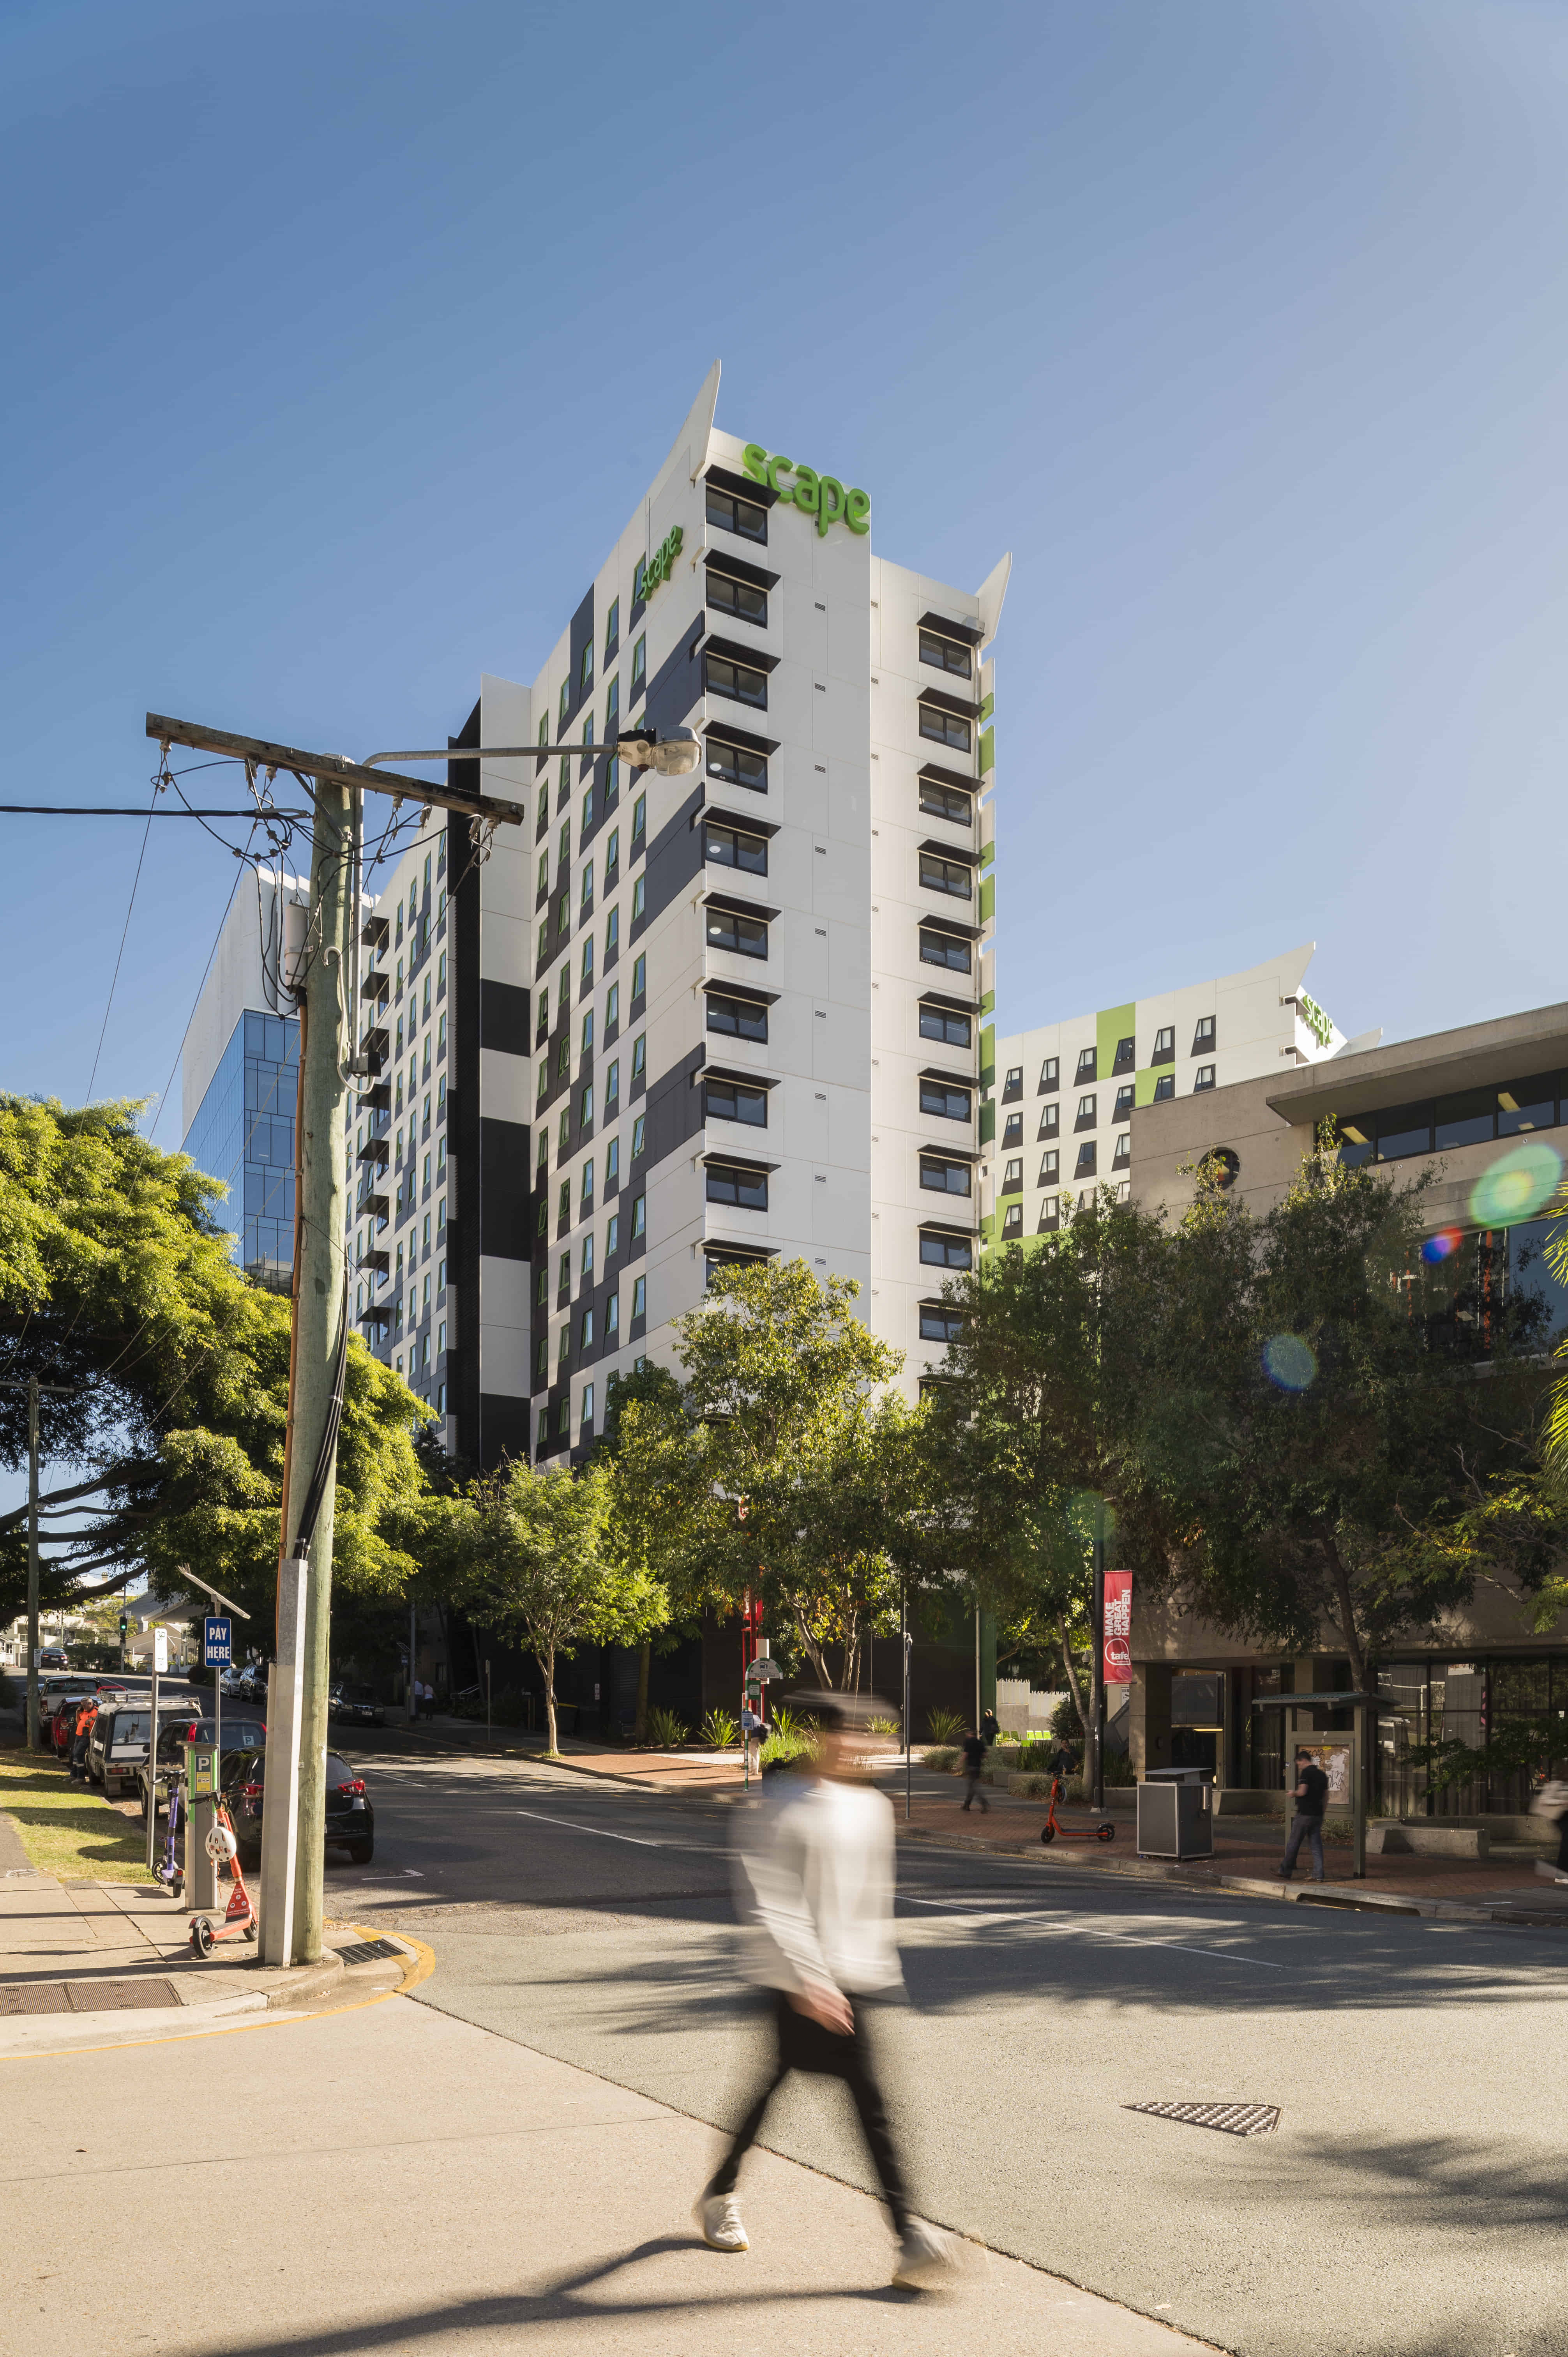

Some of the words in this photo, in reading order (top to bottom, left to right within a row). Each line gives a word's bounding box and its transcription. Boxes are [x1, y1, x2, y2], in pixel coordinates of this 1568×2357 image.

[743, 443, 870, 537] scape
[637, 525, 683, 601] scape
[1303, 994, 1333, 1046] scape
[1105, 1602, 1114, 1636] MAKE
[1121, 1589, 1130, 1636] HAPPEN
[209, 1627, 227, 1640] PAY
[207, 1646, 230, 1659] HERE
[1111, 1651, 1128, 1659] tafe
[198, 1757, 209, 1771] P
